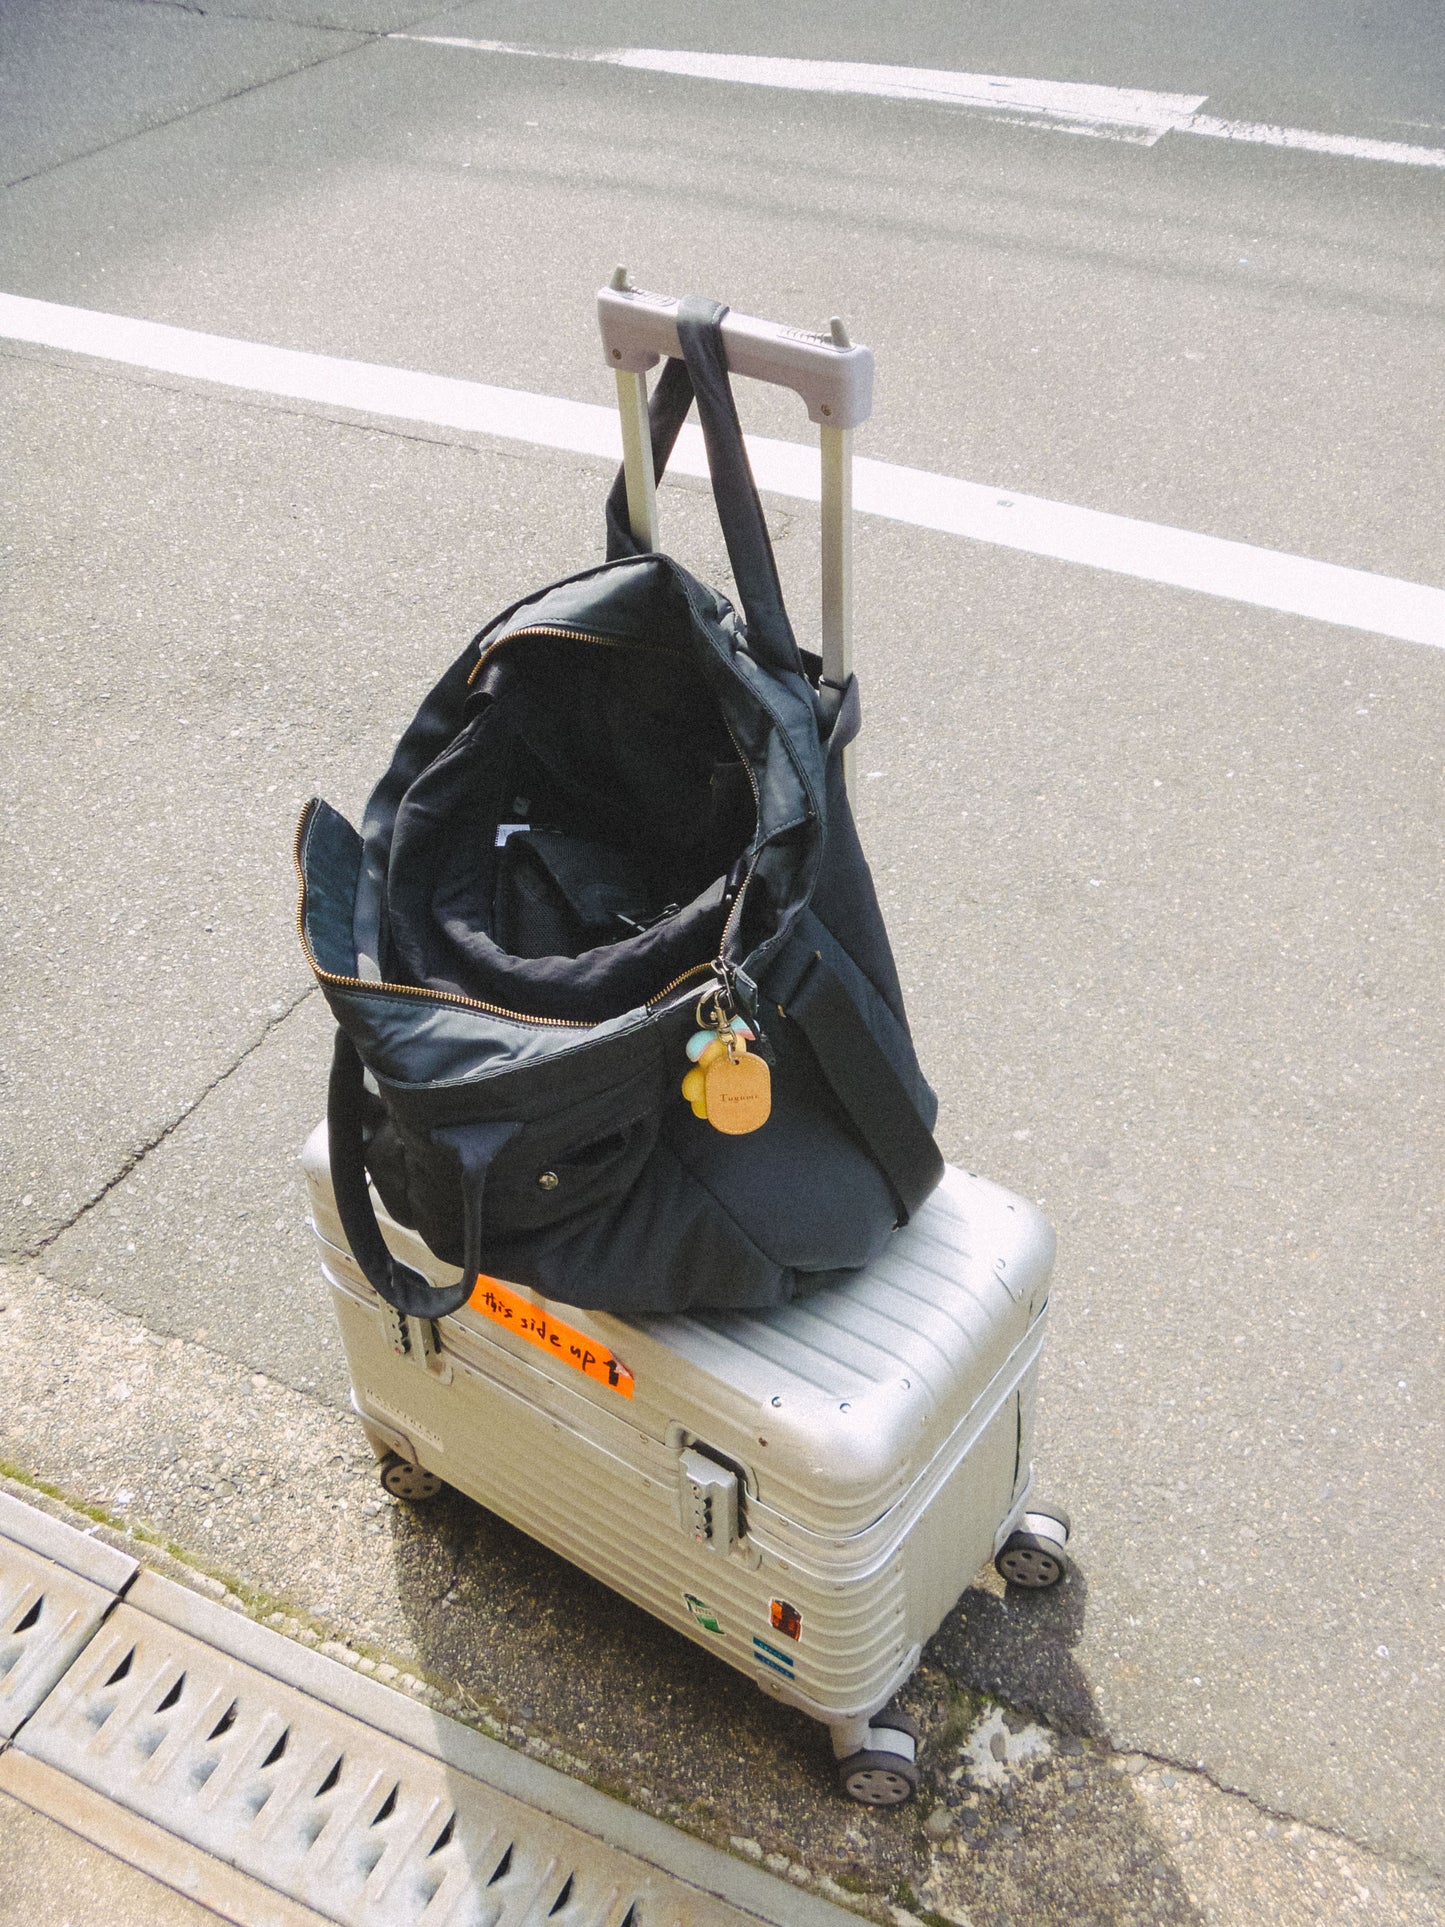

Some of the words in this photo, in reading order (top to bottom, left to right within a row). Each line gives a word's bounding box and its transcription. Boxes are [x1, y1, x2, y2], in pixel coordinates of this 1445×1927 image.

[482, 1292, 513, 1318] this
[521, 1318, 561, 1347] side
[570, 1345, 596, 1371] up
